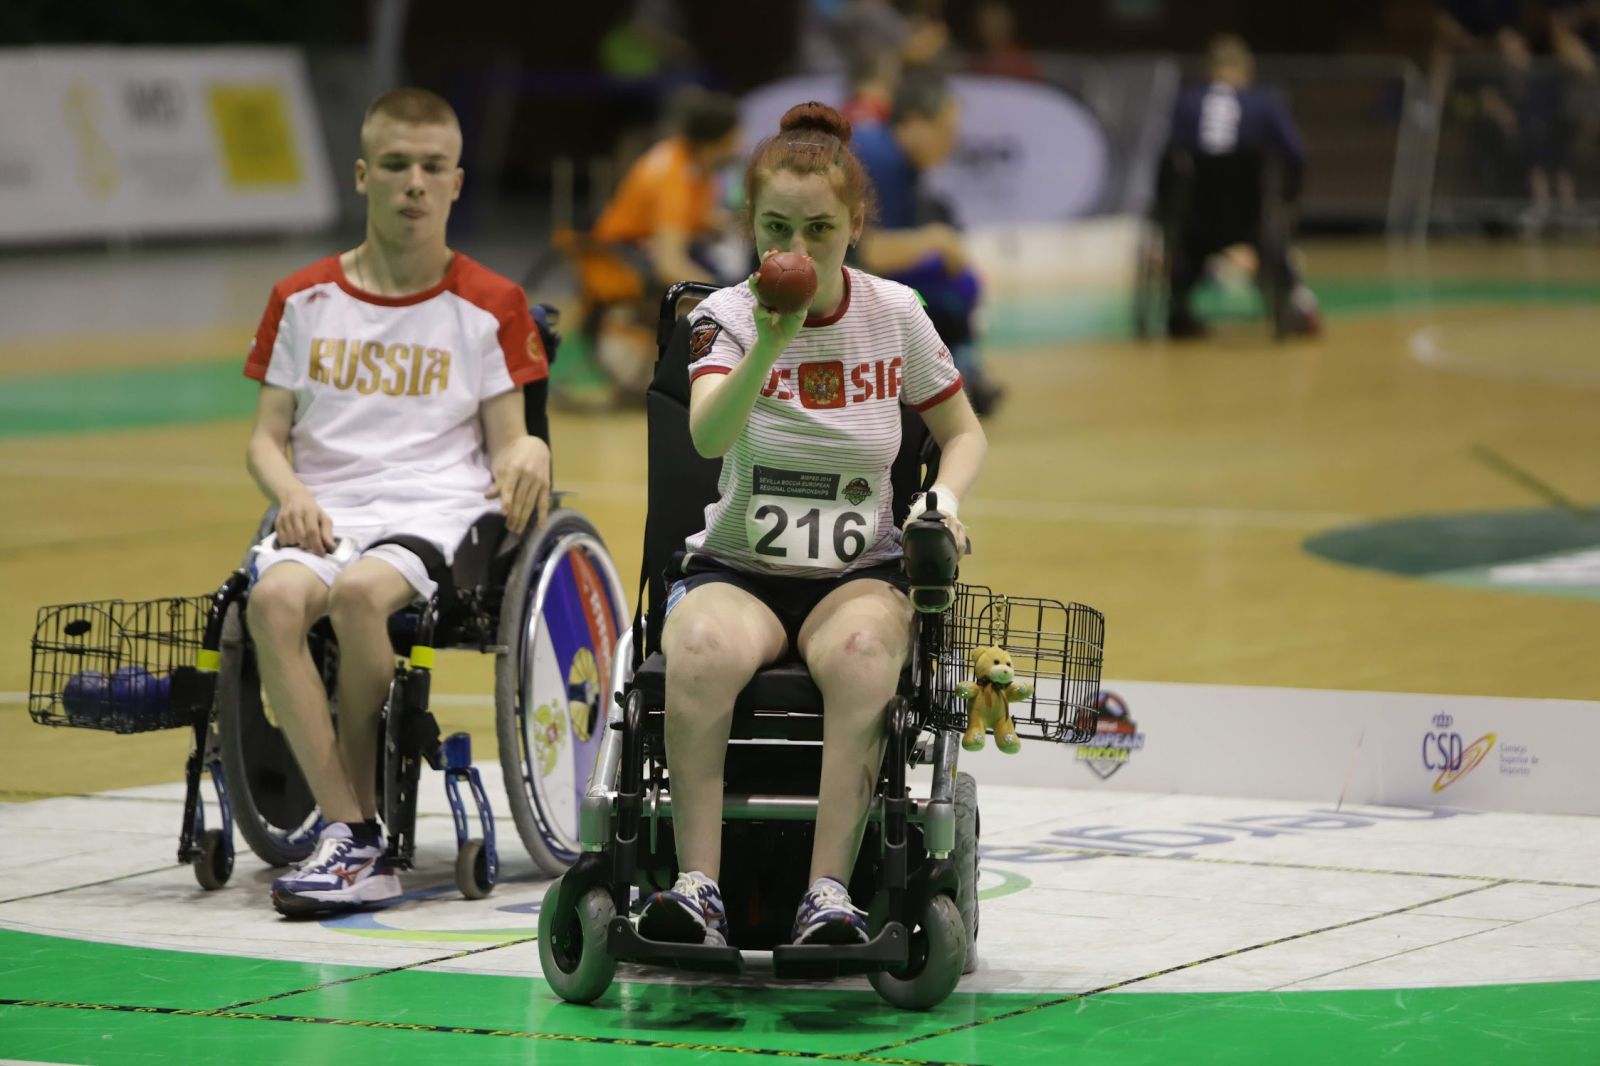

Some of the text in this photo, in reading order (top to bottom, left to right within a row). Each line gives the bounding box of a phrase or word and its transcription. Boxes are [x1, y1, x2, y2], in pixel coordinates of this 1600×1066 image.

[309, 338, 451, 396] RUSSIA
[760, 367, 794, 400] US
[760, 485, 829, 496] REGIONAL CHAMPIONSHIPS
[754, 505, 866, 563] 216
[1423, 732, 1462, 771] CSD
